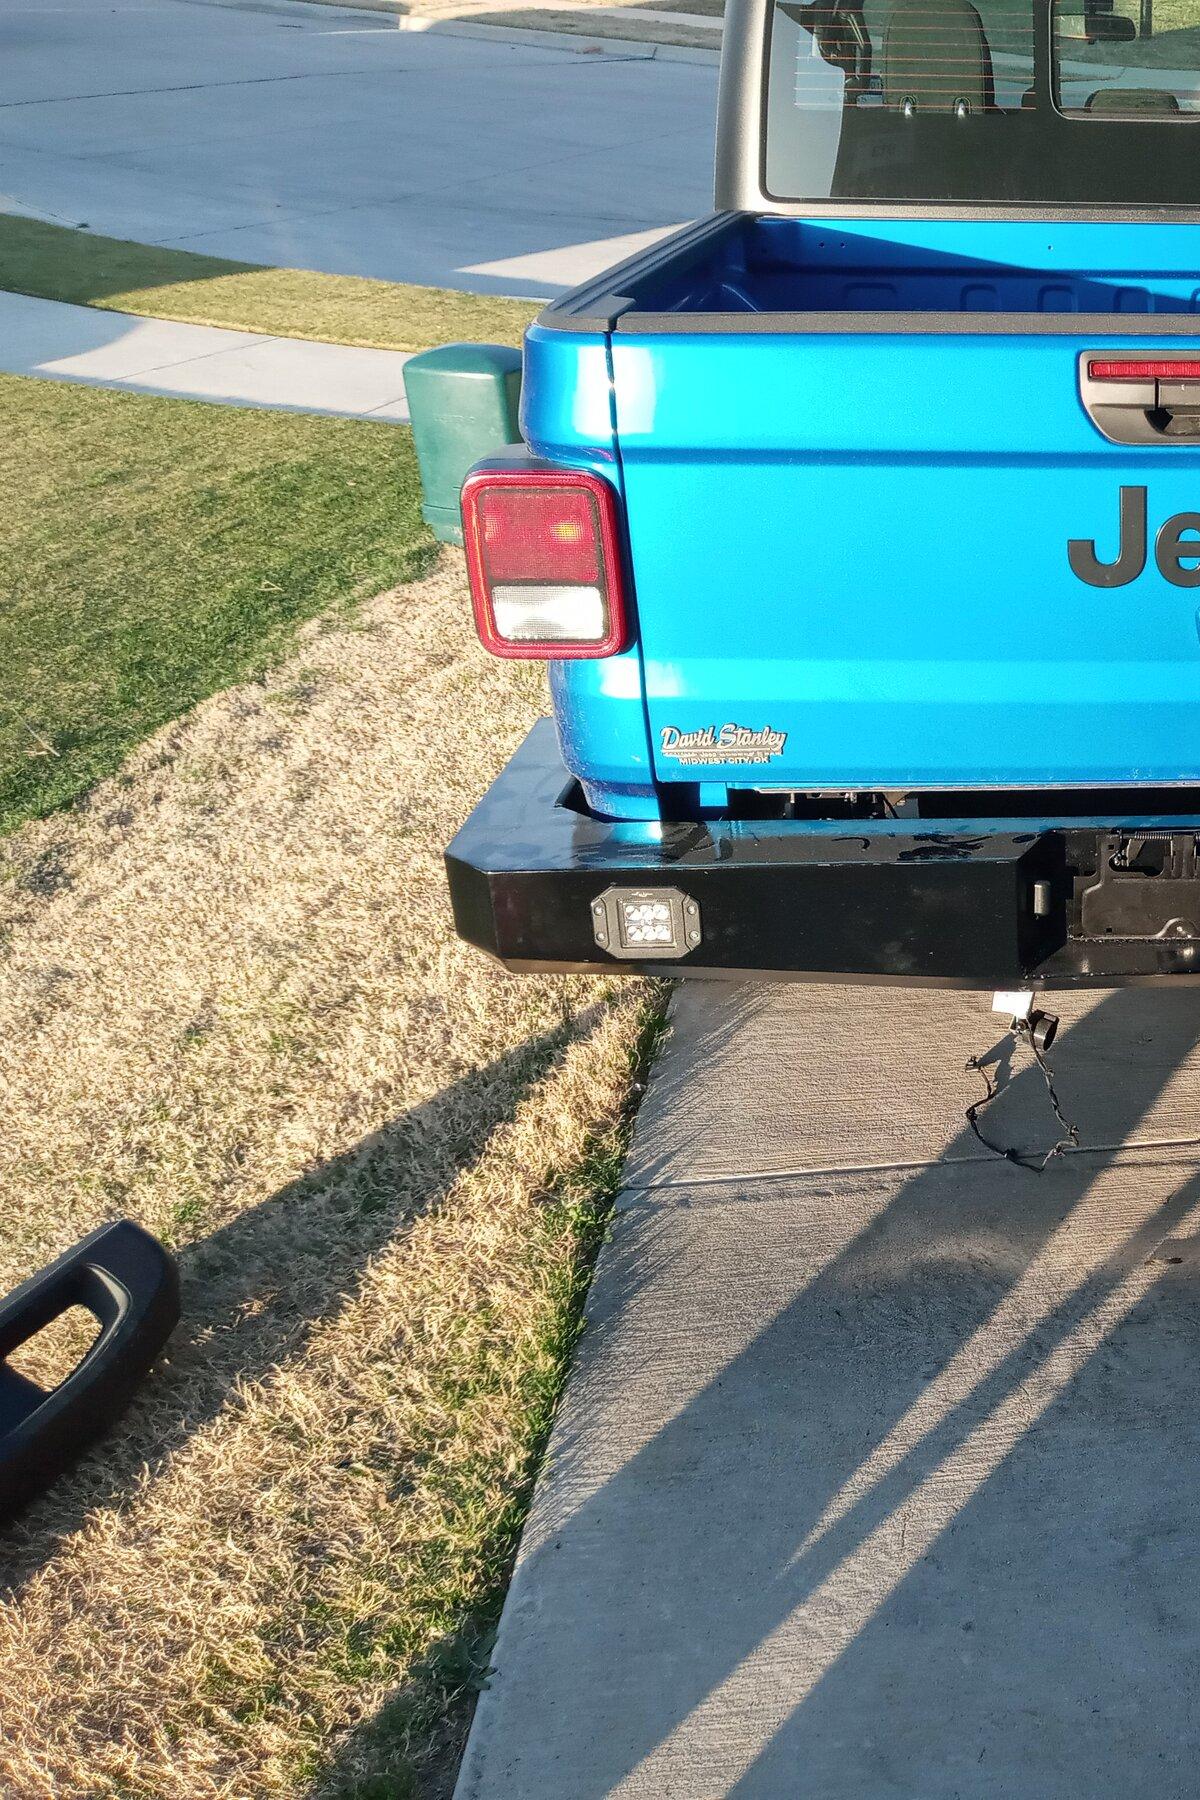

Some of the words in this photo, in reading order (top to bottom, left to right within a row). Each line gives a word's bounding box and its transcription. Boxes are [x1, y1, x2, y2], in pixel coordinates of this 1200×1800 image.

[660, 725, 716, 749] David
[716, 722, 787, 754] Stanley
[679, 756, 726, 765] MIDWEST
[753, 756, 769, 764] OK
